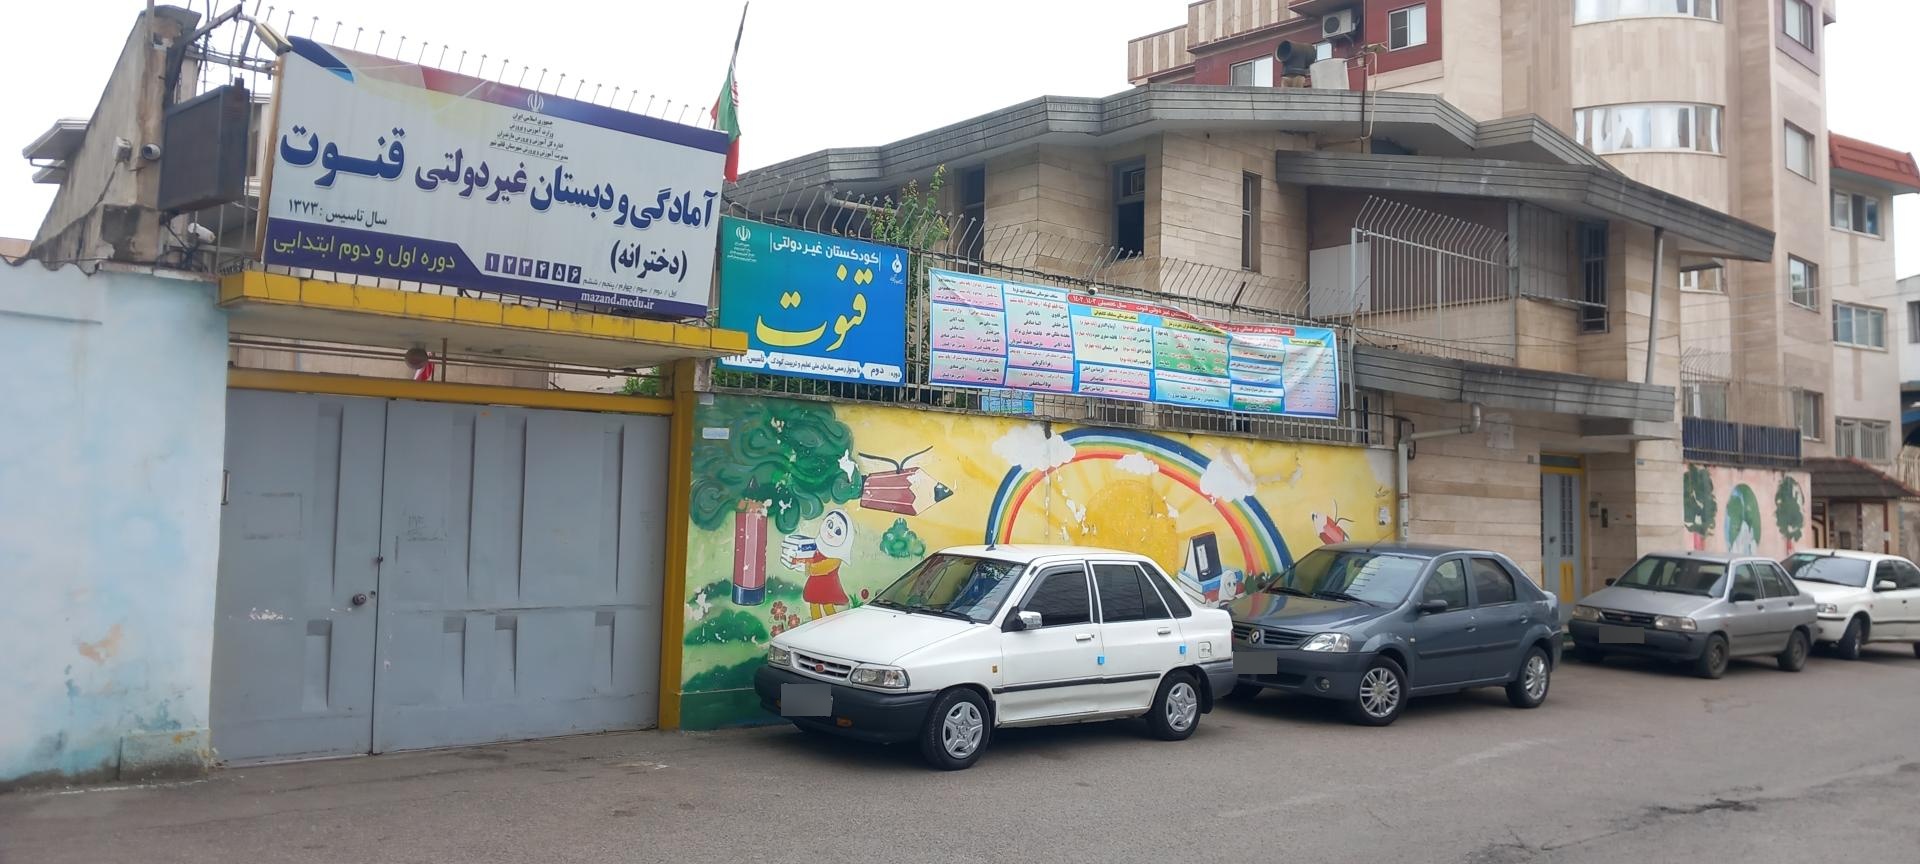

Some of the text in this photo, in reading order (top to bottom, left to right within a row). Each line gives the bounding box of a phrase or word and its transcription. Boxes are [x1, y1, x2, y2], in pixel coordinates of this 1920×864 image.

[280, 124, 406, 188] قنوت
[530, 165, 615, 219] دبستان
[630, 187, 718, 229] آمادگی
[364, 209, 388, 228] سال
[273, 231, 456, 272] دوره اول و دوم ابتدایی
[610, 239, 688, 283] (دخترانه)
[825, 244, 879, 265] کودکستان
[581, 291, 655, 310] mazand.medu.ir
[756, 264, 873, 352] قنوت
[870, 367, 885, 377] دوم
